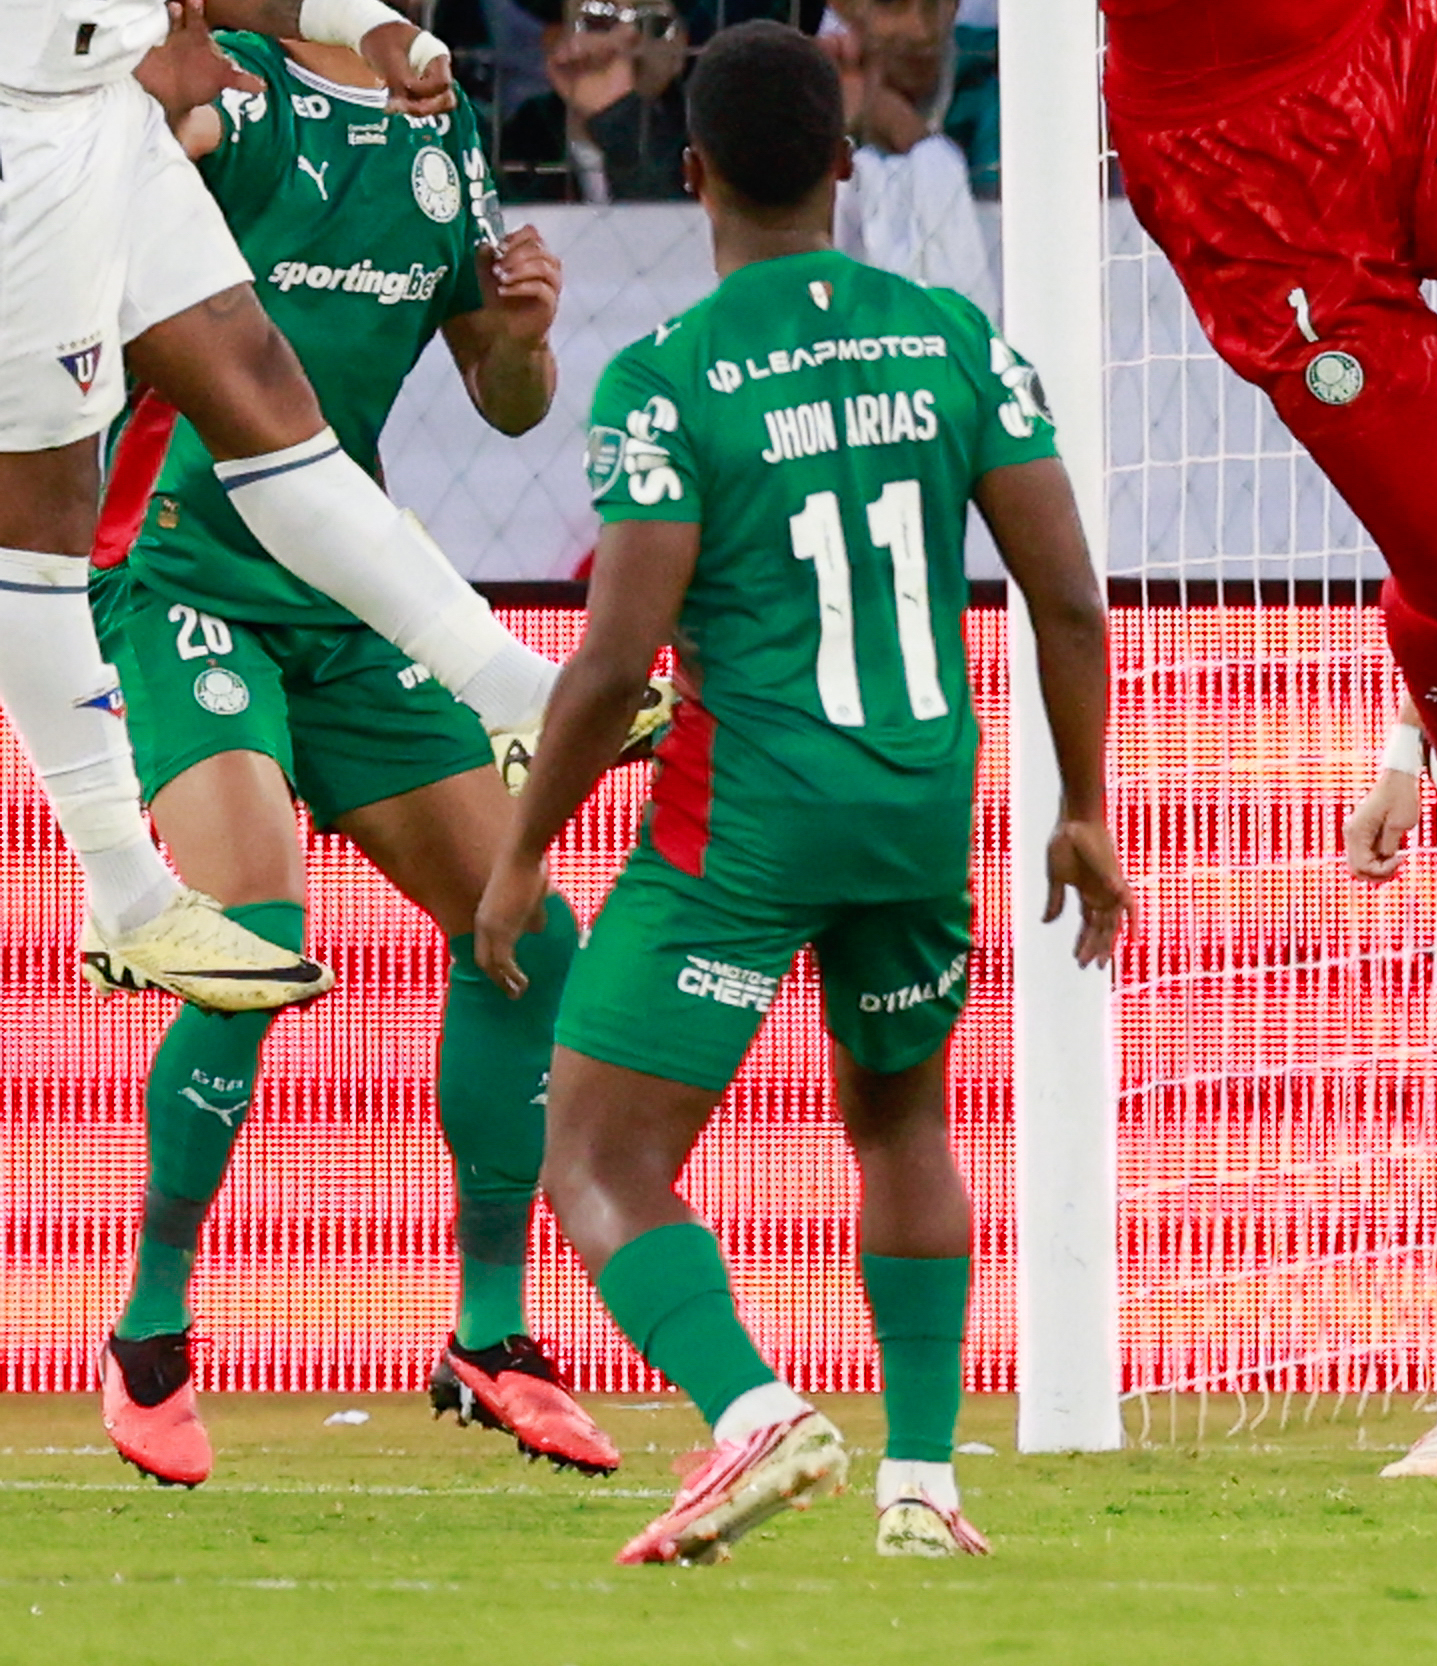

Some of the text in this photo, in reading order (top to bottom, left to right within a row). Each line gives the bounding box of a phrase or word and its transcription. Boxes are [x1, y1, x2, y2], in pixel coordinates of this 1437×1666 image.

[1288, 287, 1320, 343] 1
[745, 335, 948, 380] LEAPMOTOR
[762, 389, 938, 464] JHON ARIAS
[789, 479, 949, 727] 11
